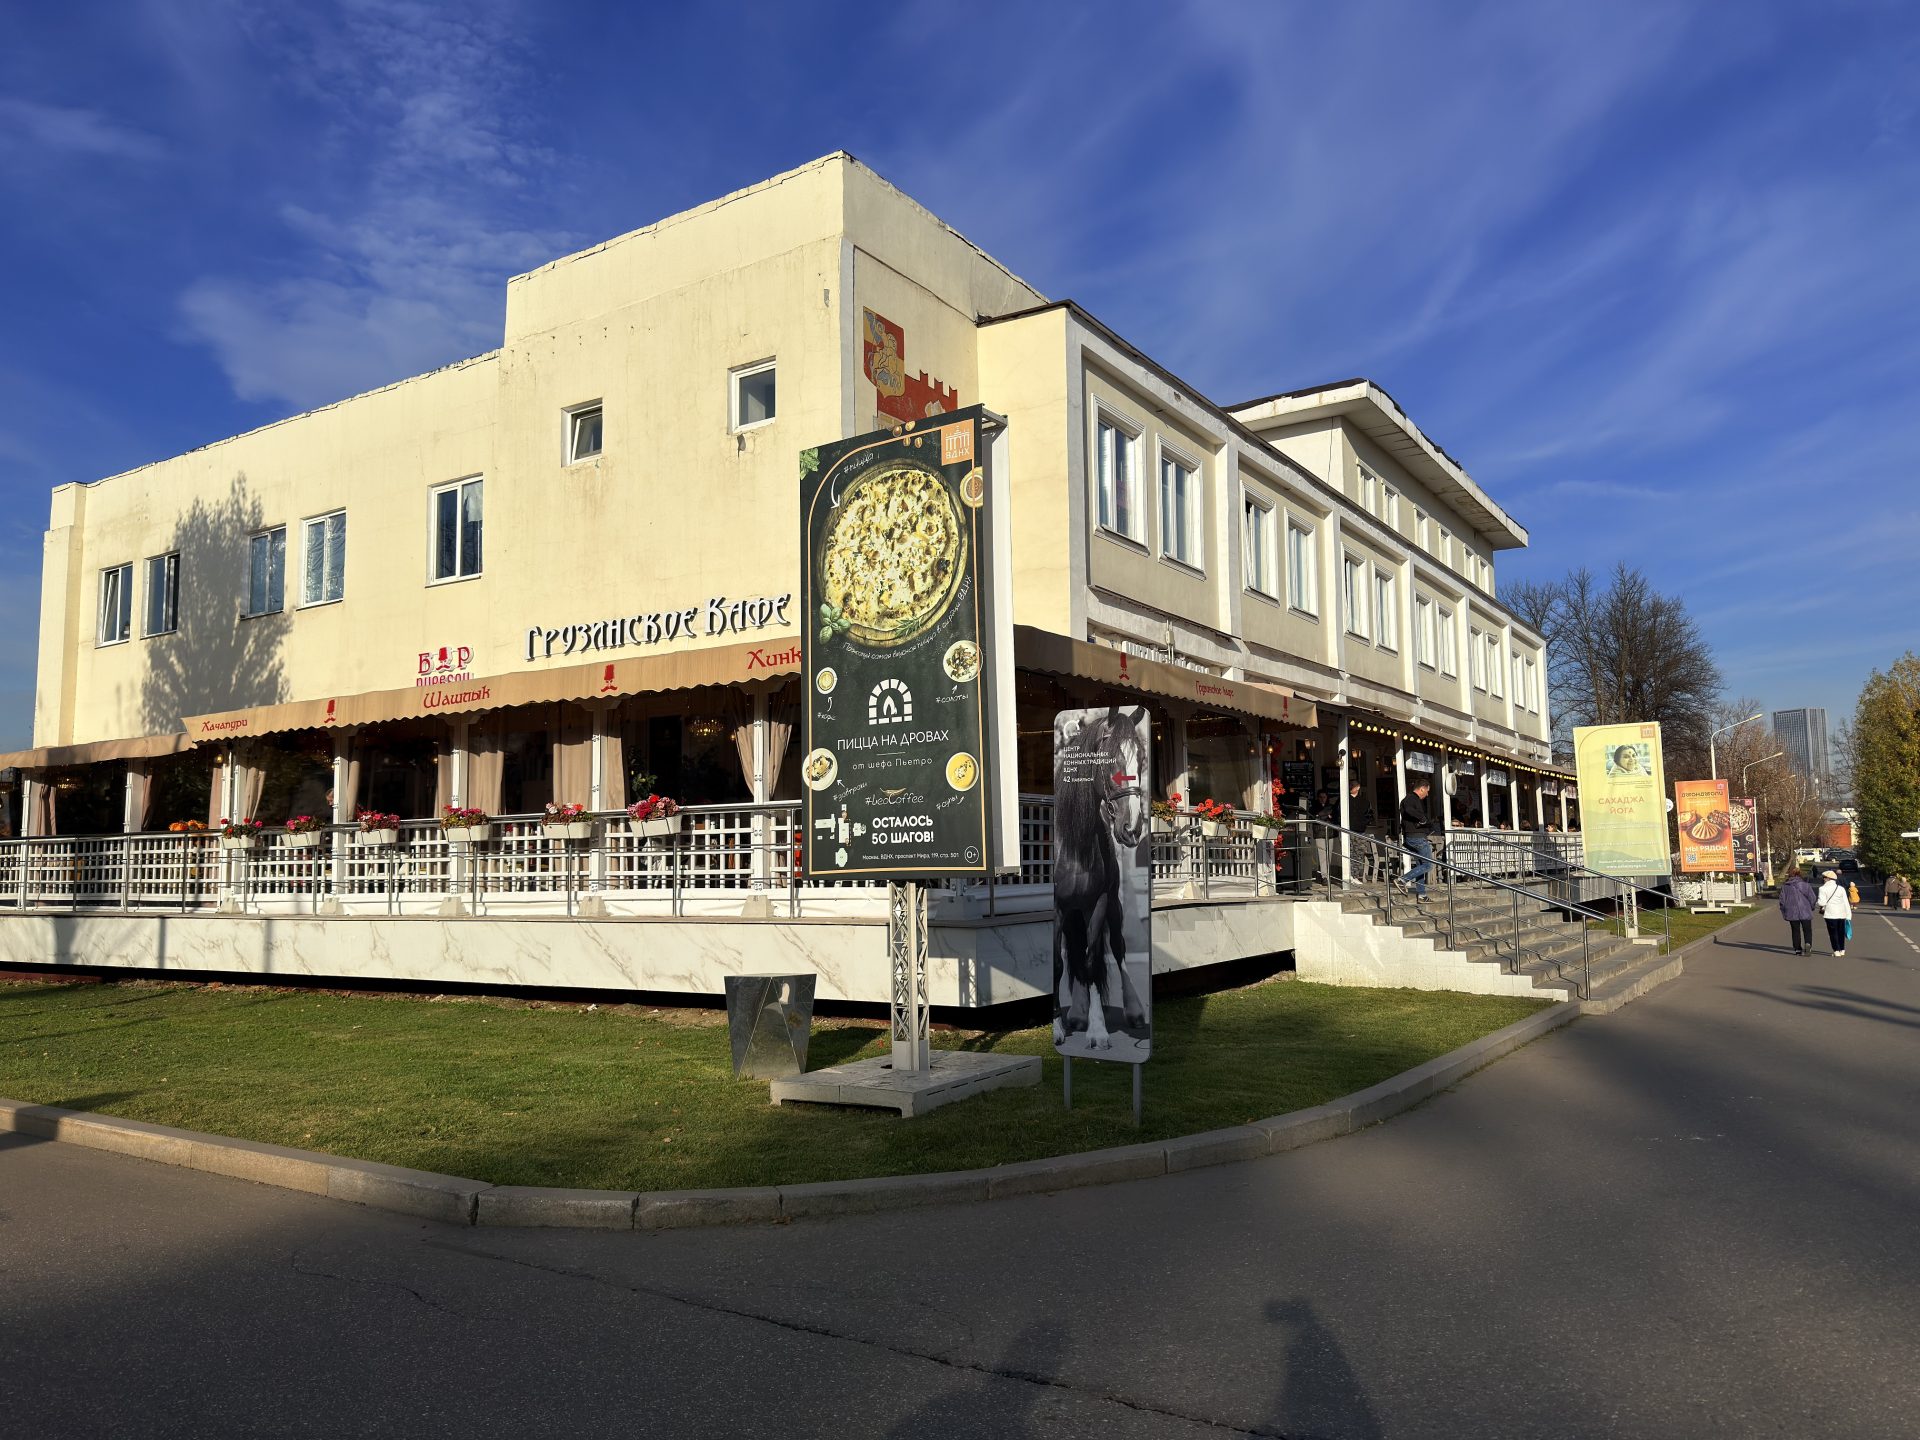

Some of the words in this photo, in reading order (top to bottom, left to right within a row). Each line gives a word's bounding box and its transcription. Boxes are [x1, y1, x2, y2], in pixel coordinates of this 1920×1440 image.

[945, 447, 970, 459] ВДНХ
[423, 685, 491, 708] Шашлык
[201, 719, 248, 732] Хачапури
[837, 735, 878, 751] ПИЦЦА
[881, 734, 898, 747] НА
[900, 730, 950, 747] ДРОВАХ
[868, 759, 892, 770] шефа
[895, 758, 933, 768] Пьетро
[1063, 775, 1071, 783] 42
[1598, 795, 1645, 805] САХАДЖА
[1609, 806, 1634, 815] ЙОГА
[872, 815, 934, 829] ОСТАЛОСЬ
[871, 832, 888, 845] 50
[890, 831, 934, 844] ШАГОВ!
[966, 851, 977, 859] 0+
